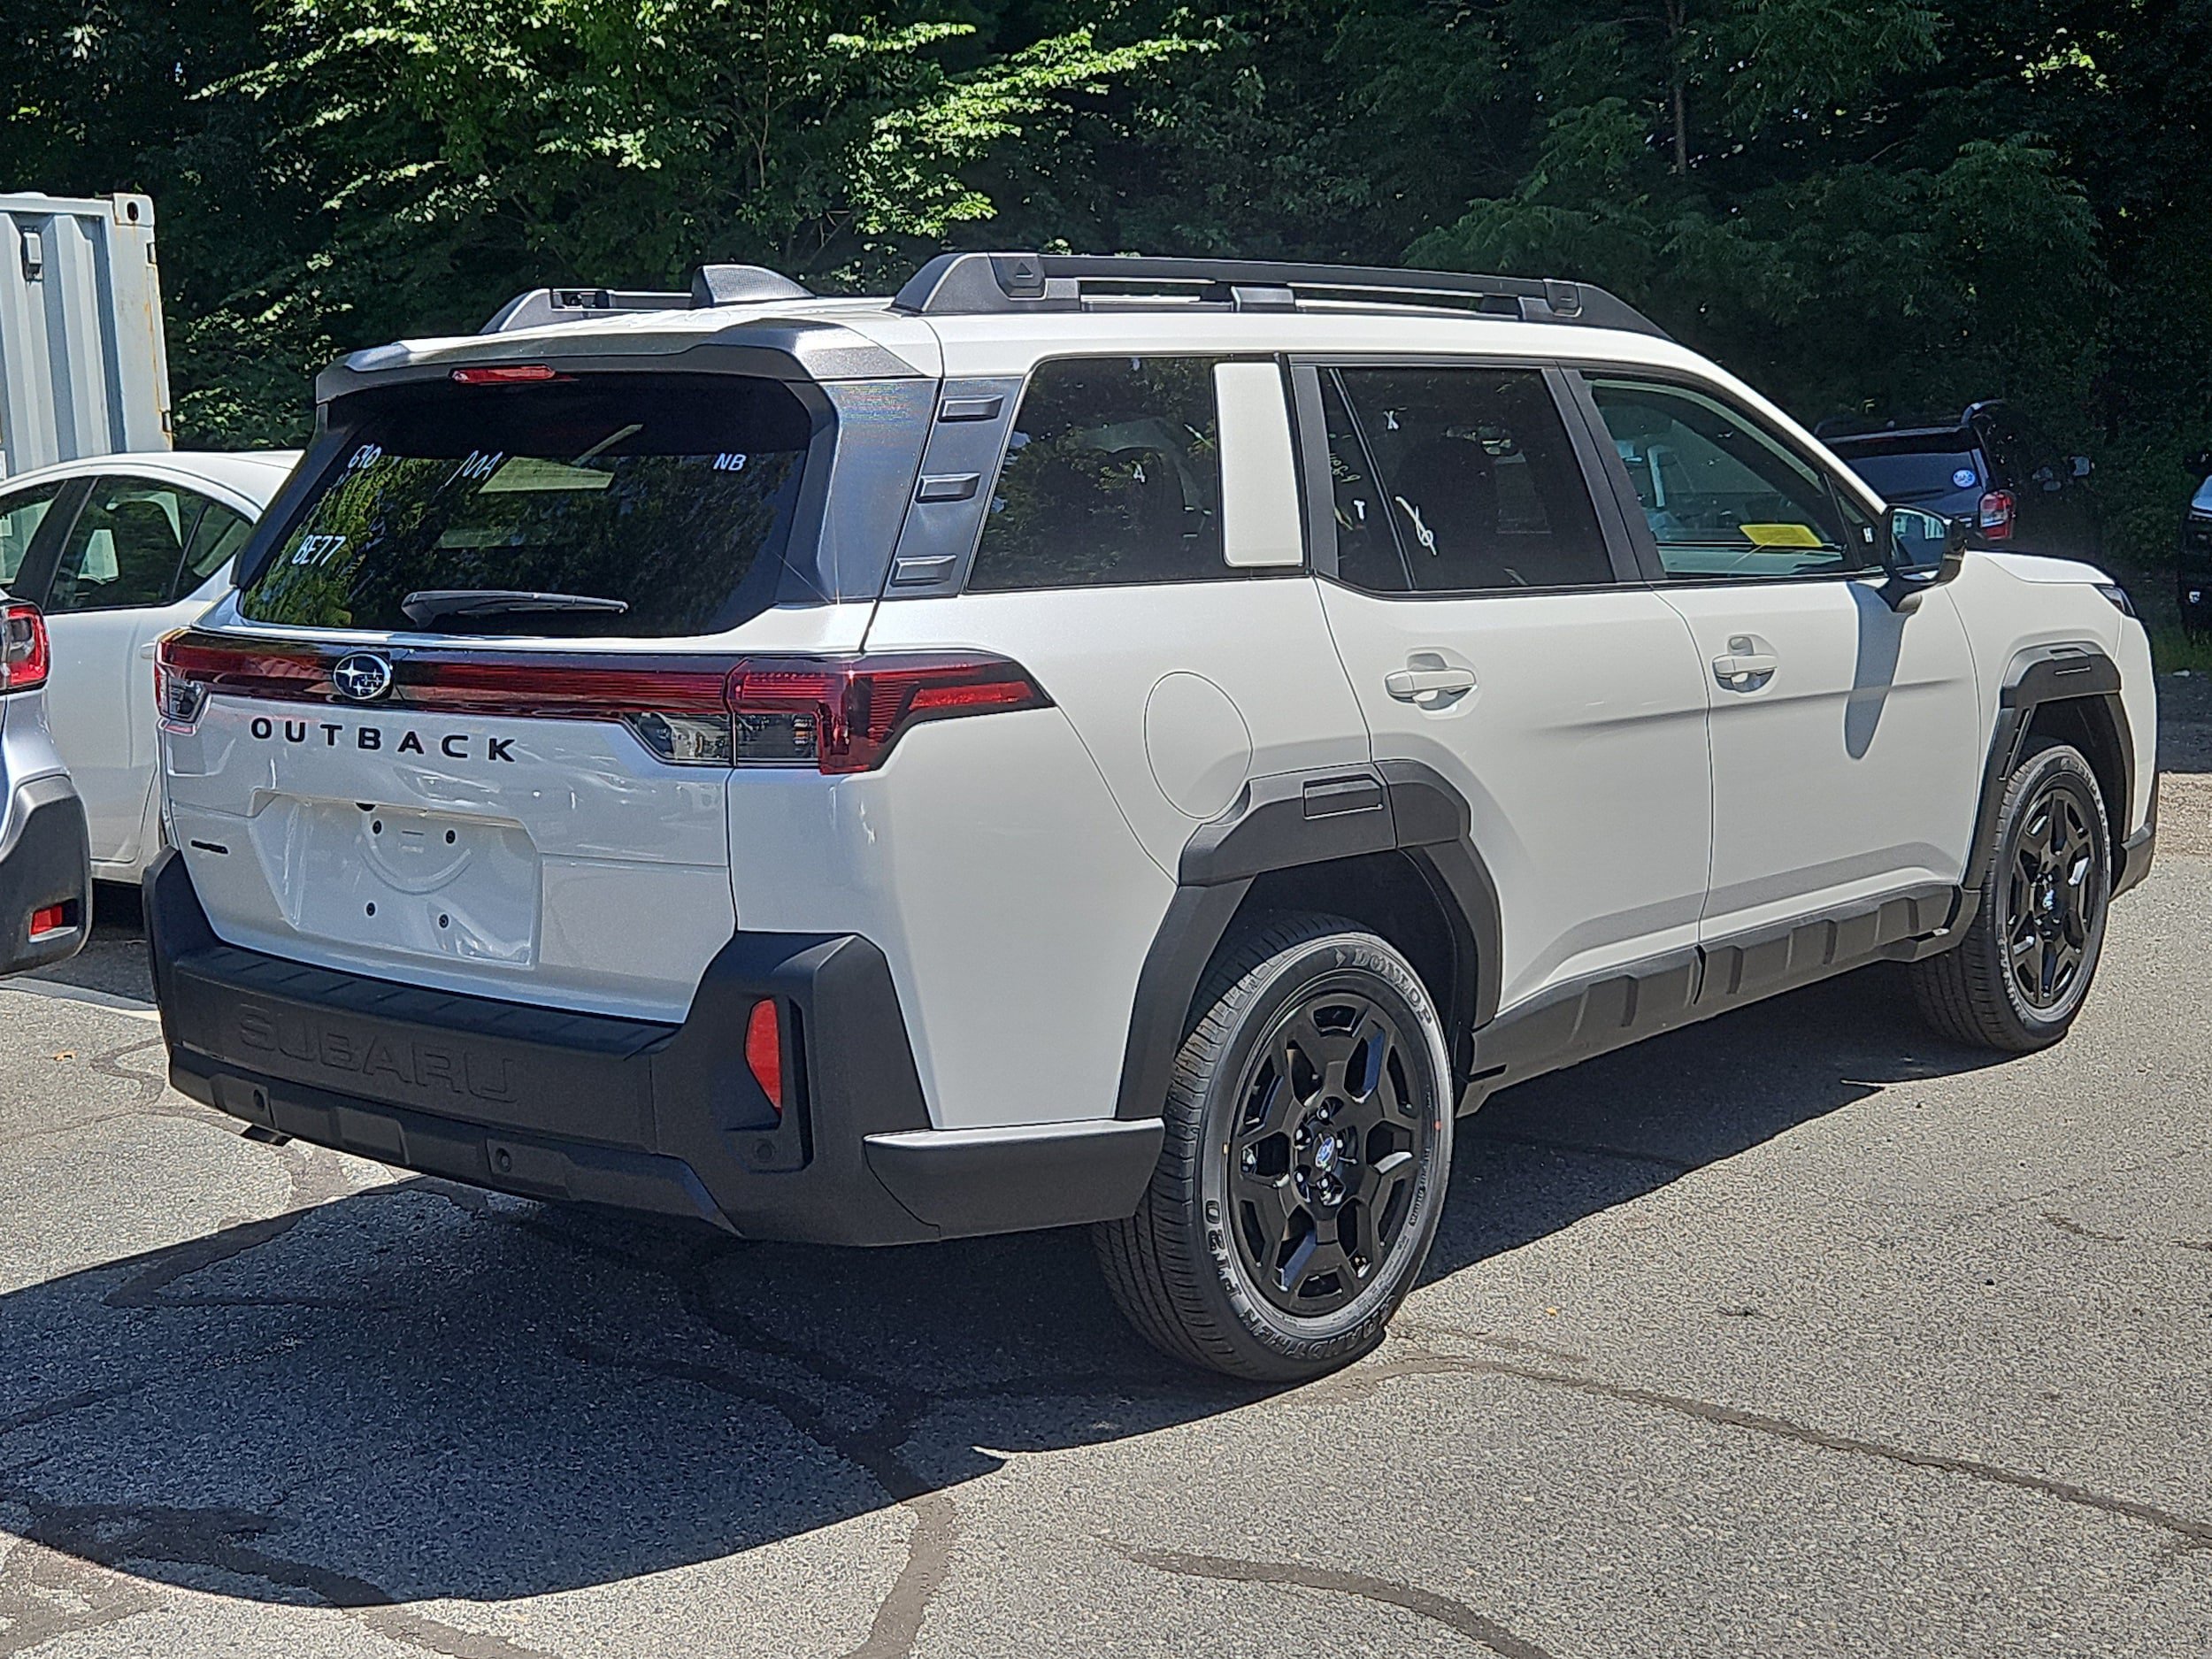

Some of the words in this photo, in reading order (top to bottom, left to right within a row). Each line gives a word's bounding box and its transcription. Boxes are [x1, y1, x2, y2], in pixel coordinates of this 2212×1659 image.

[712, 452, 747, 471] NB
[250, 718, 516, 763] OUTBACK
[1352, 949, 1433, 1025] DUNLOP
[240, 1002, 519, 1104] SUBARU
[1205, 1199, 1243, 1297] PT20
